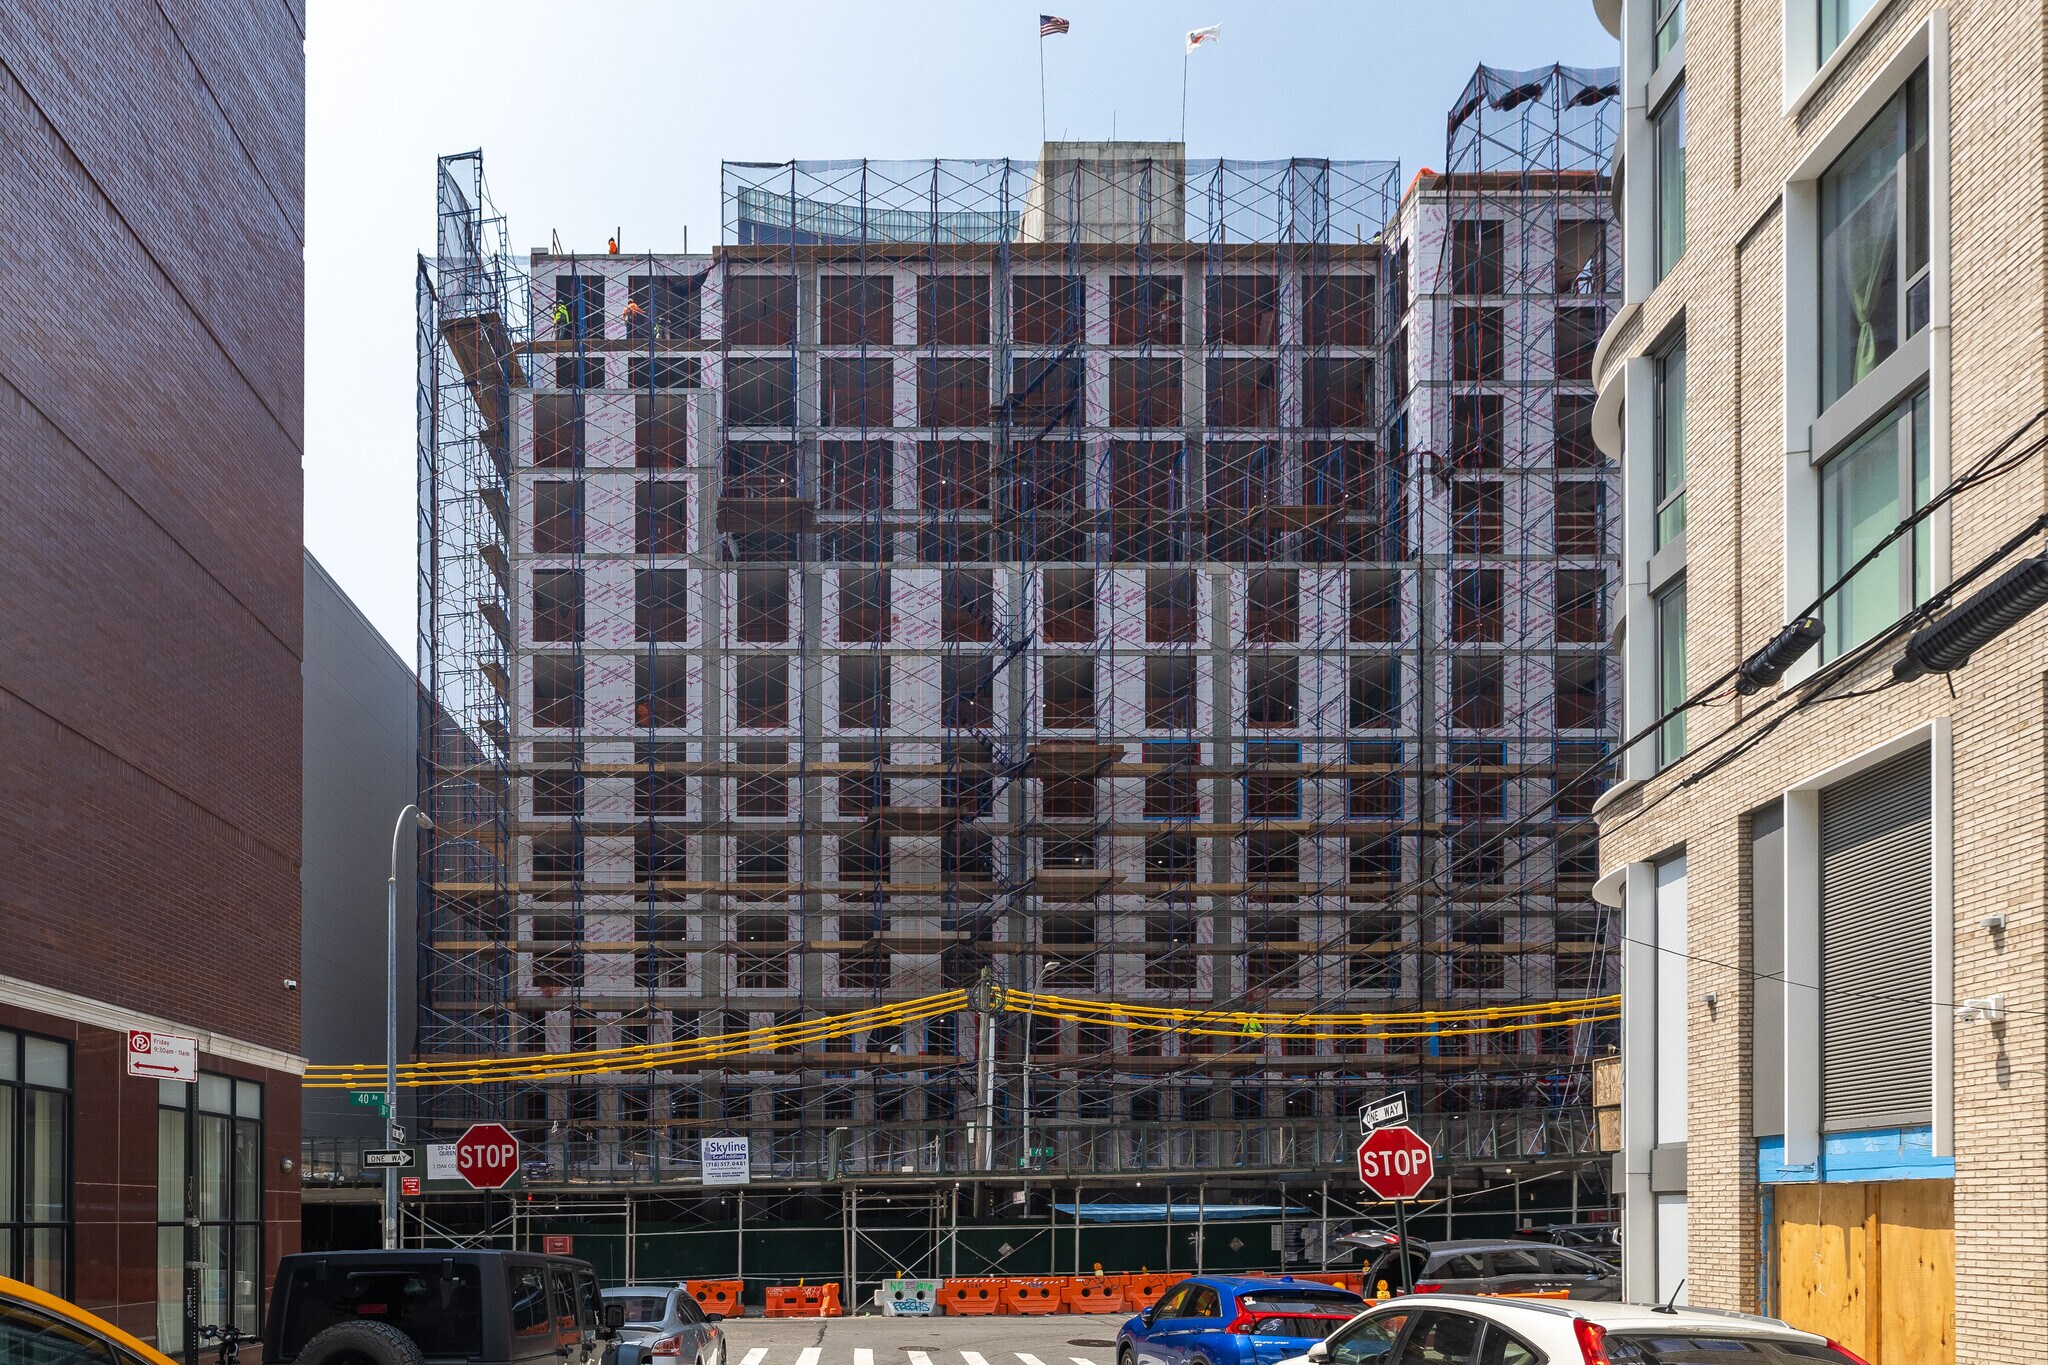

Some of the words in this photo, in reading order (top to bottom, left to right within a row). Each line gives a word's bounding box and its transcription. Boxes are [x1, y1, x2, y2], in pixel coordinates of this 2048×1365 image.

[358, 1094, 369, 1104] 40
[1367, 1111, 1378, 1124] ONE
[1384, 1103, 1400, 1117] WAY
[460, 1144, 514, 1168] STOP
[710, 1141, 746, 1154] Skyline
[1364, 1149, 1427, 1177] STOP
